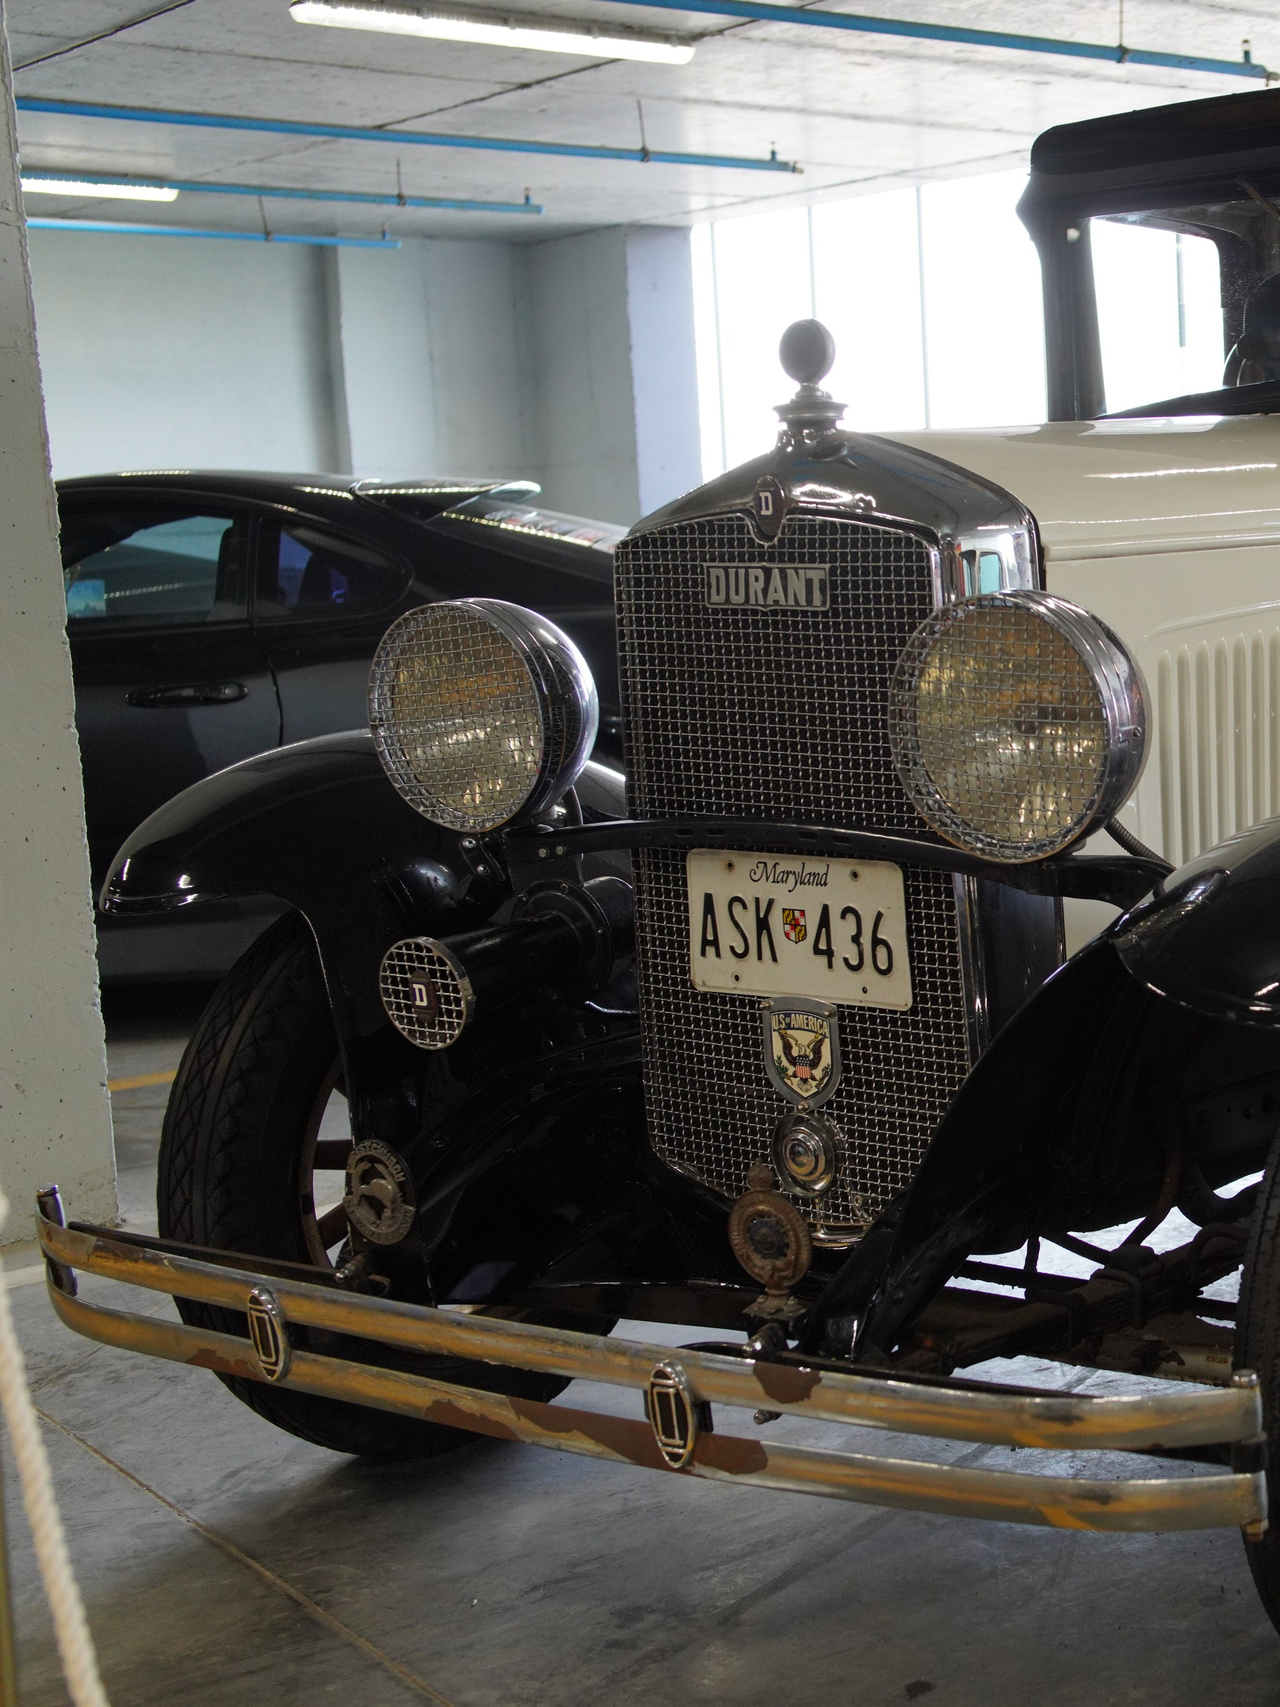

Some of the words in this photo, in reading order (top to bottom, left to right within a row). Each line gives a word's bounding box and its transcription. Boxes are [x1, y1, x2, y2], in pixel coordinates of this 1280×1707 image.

[758, 491, 773, 516] D
[708, 567, 826, 607] DURANT
[749, 860, 831, 893] Maryland
[700, 892, 779, 963] ASK
[812, 903, 894, 976] 436
[412, 983, 428, 1006] D
[772, 1014, 786, 1030] U.S.
[790, 1013, 829, 1036] AMERICA
